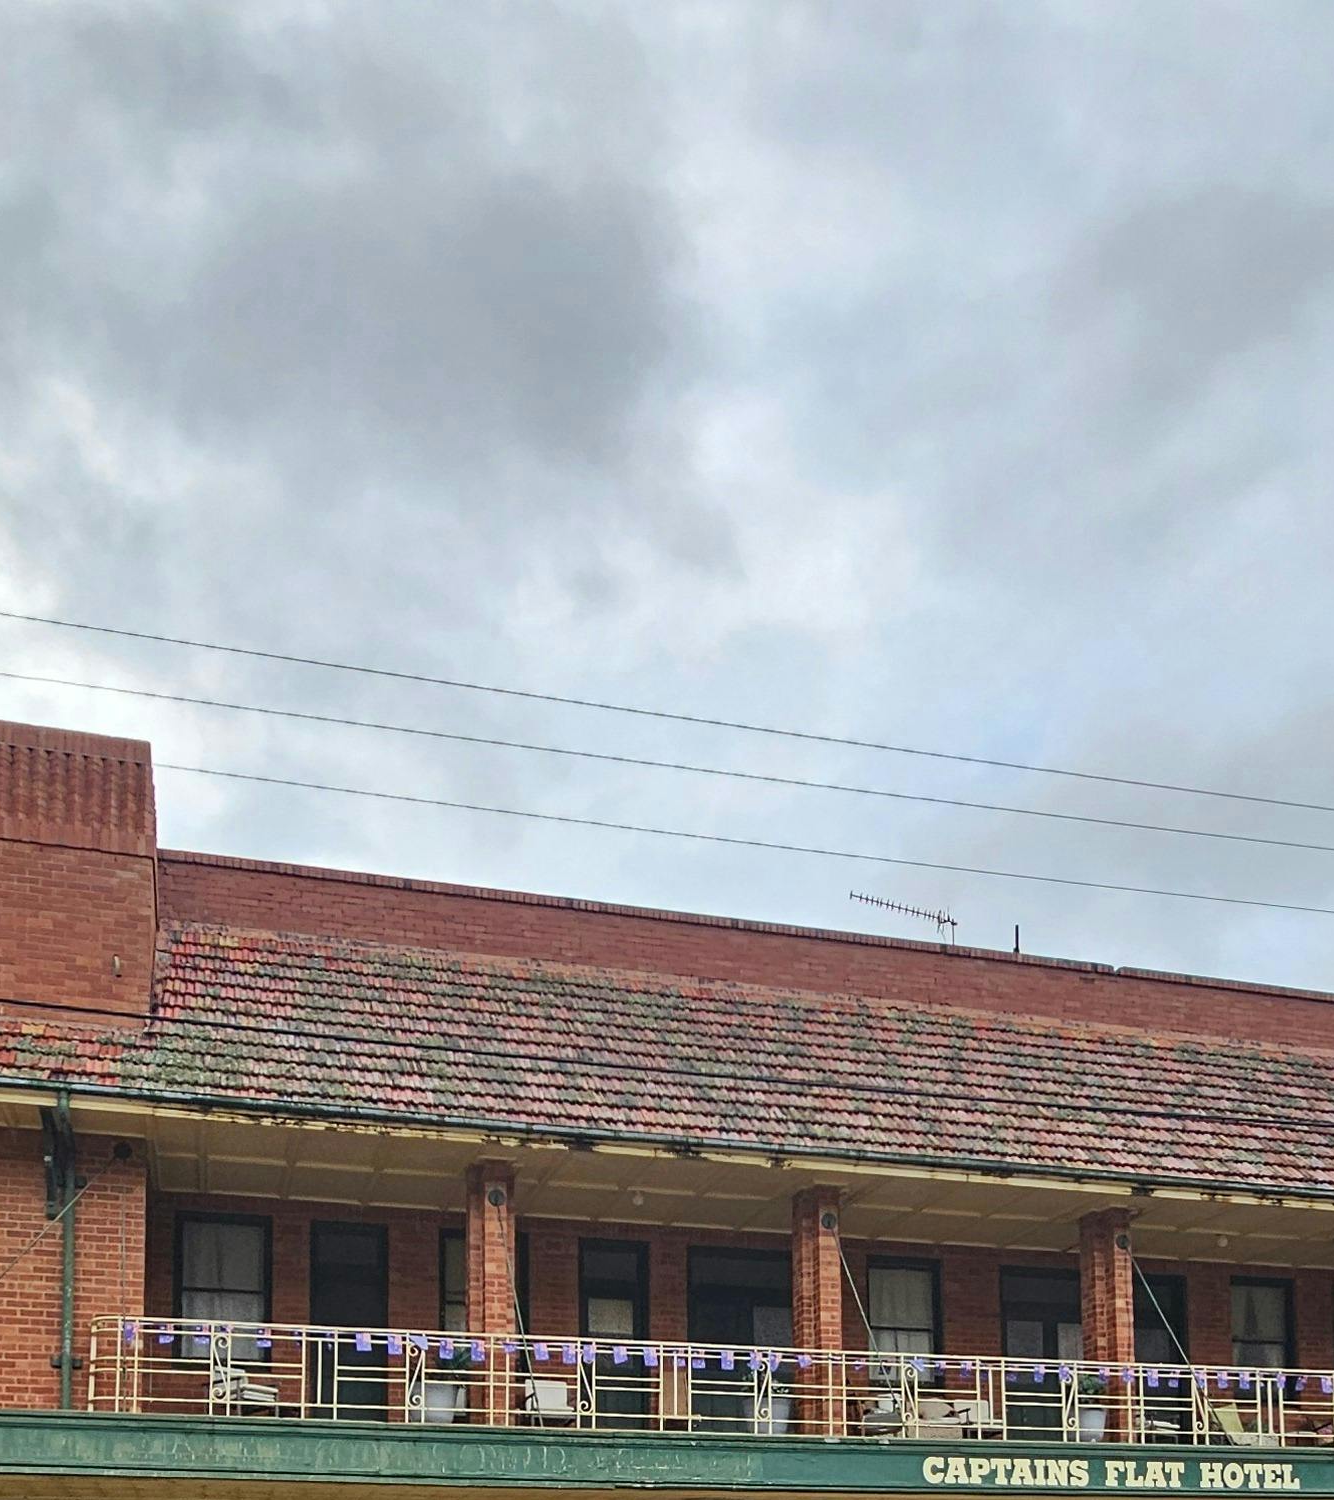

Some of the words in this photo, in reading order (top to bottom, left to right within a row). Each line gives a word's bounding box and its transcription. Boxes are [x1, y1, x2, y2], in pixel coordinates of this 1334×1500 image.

[922, 1456, 1089, 1487] CAPTAINS
[1104, 1460, 1185, 1488] FLAT
[1200, 1462, 1301, 1490] HOTEL
